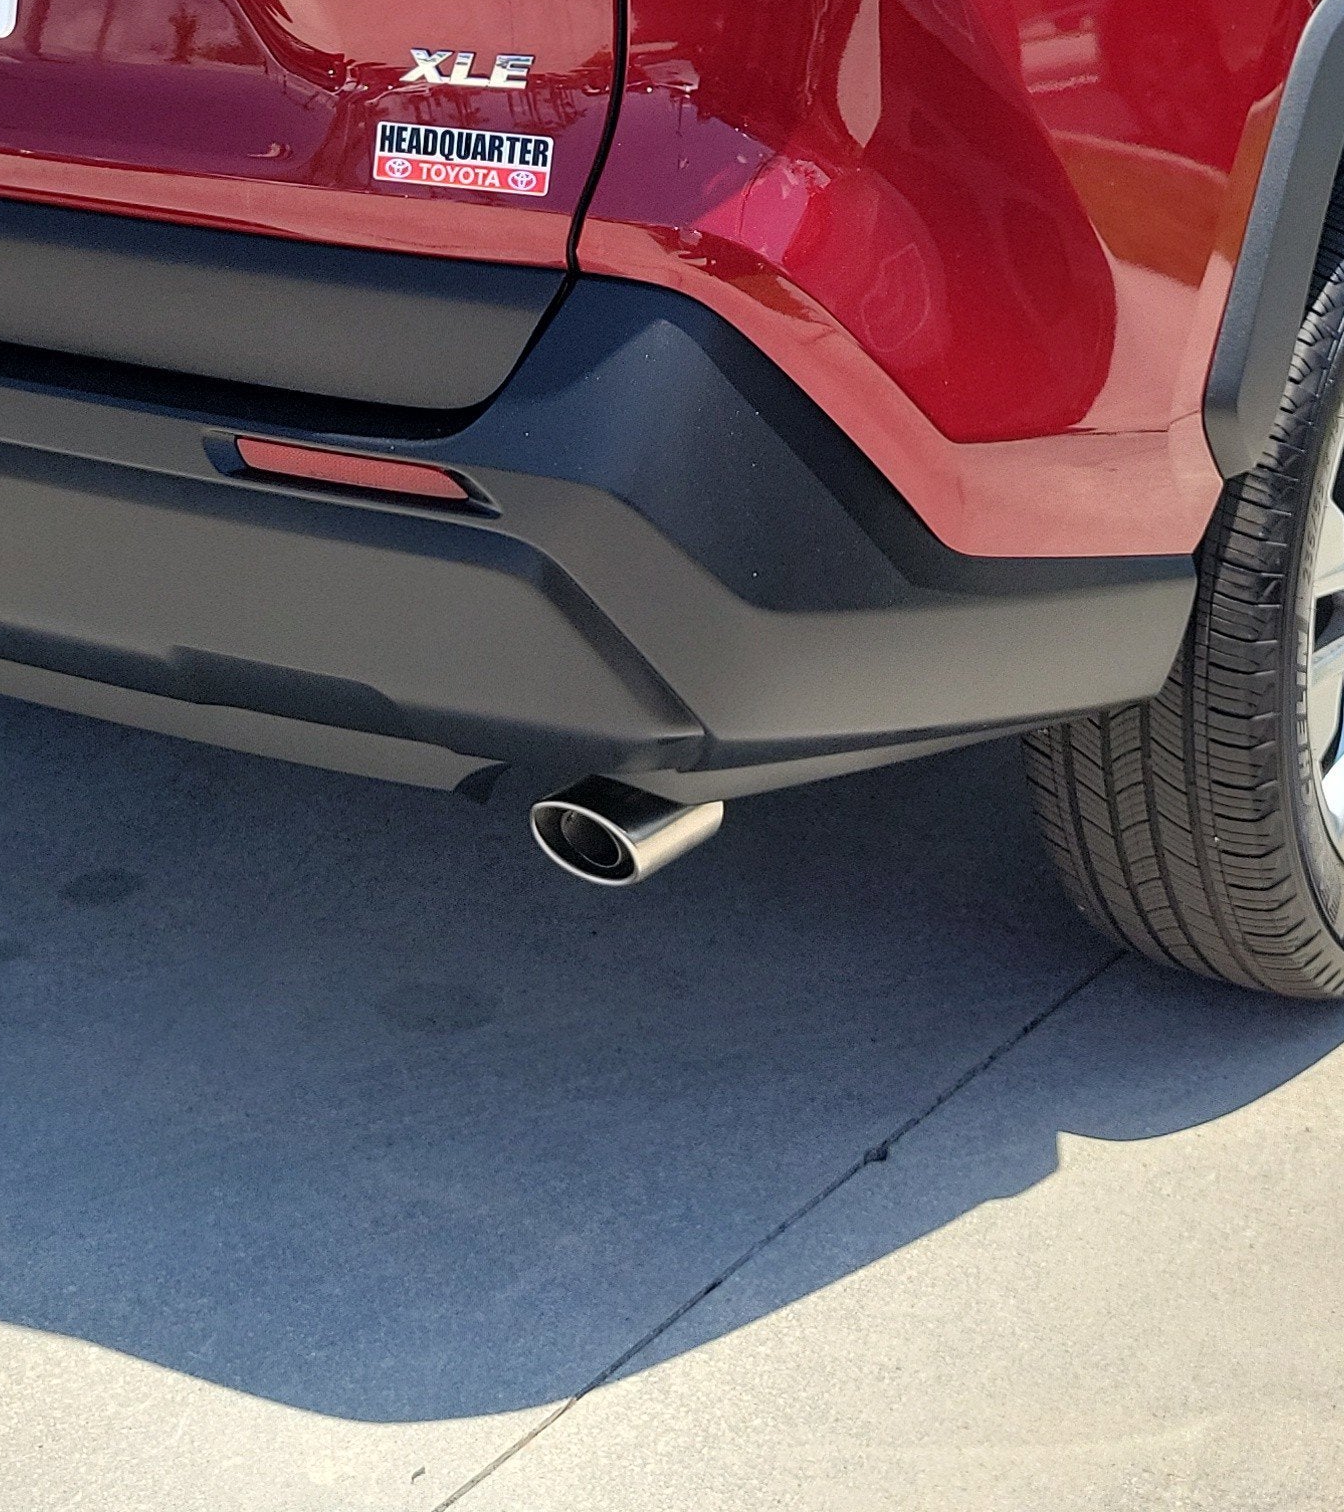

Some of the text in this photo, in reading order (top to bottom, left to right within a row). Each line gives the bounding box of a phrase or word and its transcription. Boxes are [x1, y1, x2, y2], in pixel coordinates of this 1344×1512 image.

[399, 47, 536, 90] XLE
[378, 124, 550, 168] HEADQUARTER
[418, 162, 502, 188] TOYOTA
